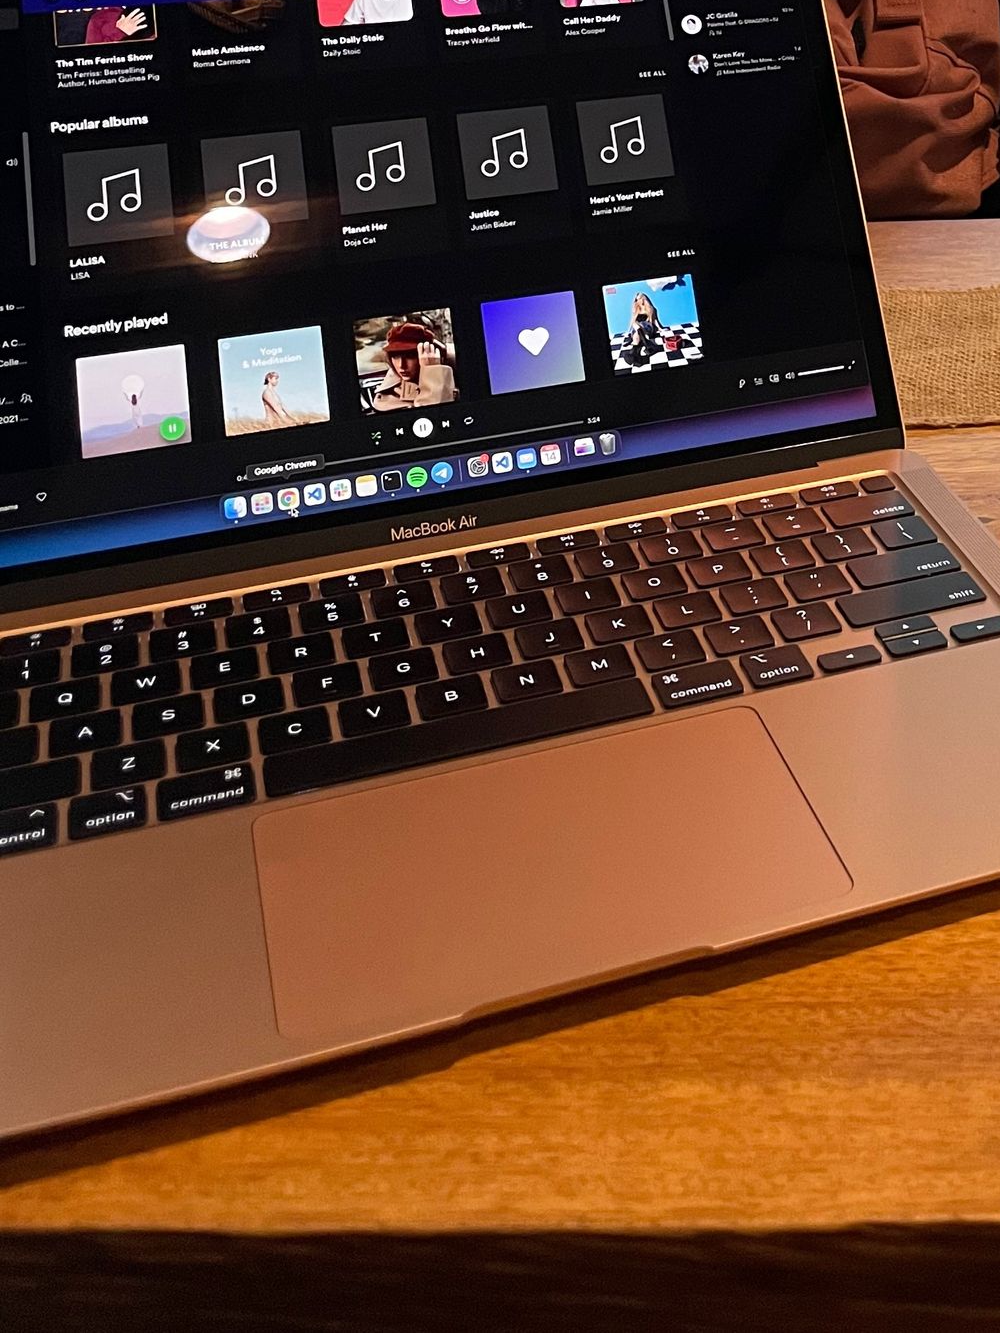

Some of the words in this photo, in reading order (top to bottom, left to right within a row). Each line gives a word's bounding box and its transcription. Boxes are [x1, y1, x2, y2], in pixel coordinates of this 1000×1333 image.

[563, 16, 580, 26] Call
[580, 15, 595, 25] Her
[595, 13, 621, 25] Daddy
[445, 26, 478, 36] Breathe
[477, 24, 491, 33] Go
[491, 22, 512, 32] Flow
[565, 28, 580, 37] Alex
[580, 27, 606, 37] Cooper
[321, 37, 338, 47] The
[339, 34, 361, 46] Daily
[362, 32, 385, 44] Stoic
[470, 35, 501, 45] Warfield
[191, 46, 219, 57] Music
[220, 43, 266, 55] Ambience
[322, 49, 341, 58] Daily
[342, 47, 362, 57] Stoic
[712, 52, 732, 60] Karen
[55, 59, 75, 69] The
[74, 58, 94, 67] Tim
[94, 55, 126, 66] Ferriss
[126, 53, 154, 63] Show
[192, 60, 215, 69] Roma
[215, 57, 251, 68] Carmona
[57, 72, 73, 81] Tim
[73, 69, 103, 79] Ferriss:
[103, 66, 146, 77] Bestselling
[638, 71, 652, 79] SEE
[652, 69, 667, 78] ALL
[57, 79, 87, 89] Author,
[87, 77, 117, 87] Human
[117, 74, 146, 84] Guinea
[147, 73, 161, 83] Pig
[50, 118, 101, 135] Popular
[102, 115, 149, 129] albums
[589, 194, 616, 204] Here's
[615, 193, 635, 202] Your
[634, 189, 664, 200] Perfect
[469, 208, 500, 220] Justice
[591, 207, 613, 216] Jamie
[342, 224, 369, 236] Planet
[370, 222, 388, 233] Her
[470, 221, 492, 232] Justin
[492, 219, 517, 229] Bieber
[209, 240, 229, 251] THE
[230, 236, 265, 249] ALBUM
[344, 237, 362, 248] Doja
[362, 236, 377, 246] Cat
[667, 250, 681, 258] SEE
[681, 248, 696, 257] ALL
[69, 255, 106, 268] LALISA
[70, 271, 91, 281] LISA
[64, 319, 122, 338] Recently
[123, 311, 169, 332] played
[259, 346, 283, 356] Yoga
[241, 360, 250, 369] &
[251, 354, 303, 368] Meditation
[544, 452, 557, 462] 14
[253, 465, 284, 476] Google
[284, 459, 317, 472] Chrome
[236, 474, 248, 482] 0:4
[872, 504, 906, 516] delete
[391, 517, 456, 541] MacBook
[459, 514, 478, 530] Air
[712, 564, 724, 574] P
[916, 558, 951, 572] return
[536, 571, 549, 581] 8
[647, 577, 661, 587] O
[467, 584, 480, 594] 7
[948, 588, 976, 601] shift
[398, 598, 411, 608] 6
[511, 603, 526, 614] U
[680, 605, 694, 615] L
[327, 612, 339, 622] 5
[441, 617, 454, 629] Y
[611, 618, 627, 629] K
[252, 625, 266, 636] 4
[369, 632, 382, 643] T
[545, 632, 556, 644] J
[177, 640, 190, 651] 3
[294, 646, 308, 658] R
[470, 647, 486, 659] H
[100, 654, 113, 665] 2
[590, 658, 609, 672] M
[219, 661, 232, 673] E
[396, 662, 411, 673] G
[760, 664, 800, 680] option
[21, 670, 30, 680] 1
[518, 673, 535, 686] N
[136, 675, 157, 689] W
[321, 677, 334, 689] F
[670, 678, 734, 700] command
[57, 692, 74, 706] Q
[241, 693, 257, 706] D
[444, 690, 459, 703] B
[161, 709, 176, 721] S
[366, 706, 381, 718] V
[77, 726, 94, 739] A
[287, 722, 303, 735] C
[205, 739, 221, 754] X
[121, 756, 137, 771] Z
[170, 785, 245, 810] command
[85, 810, 136, 828] option
[0, 827, 46, 845] ontrol
